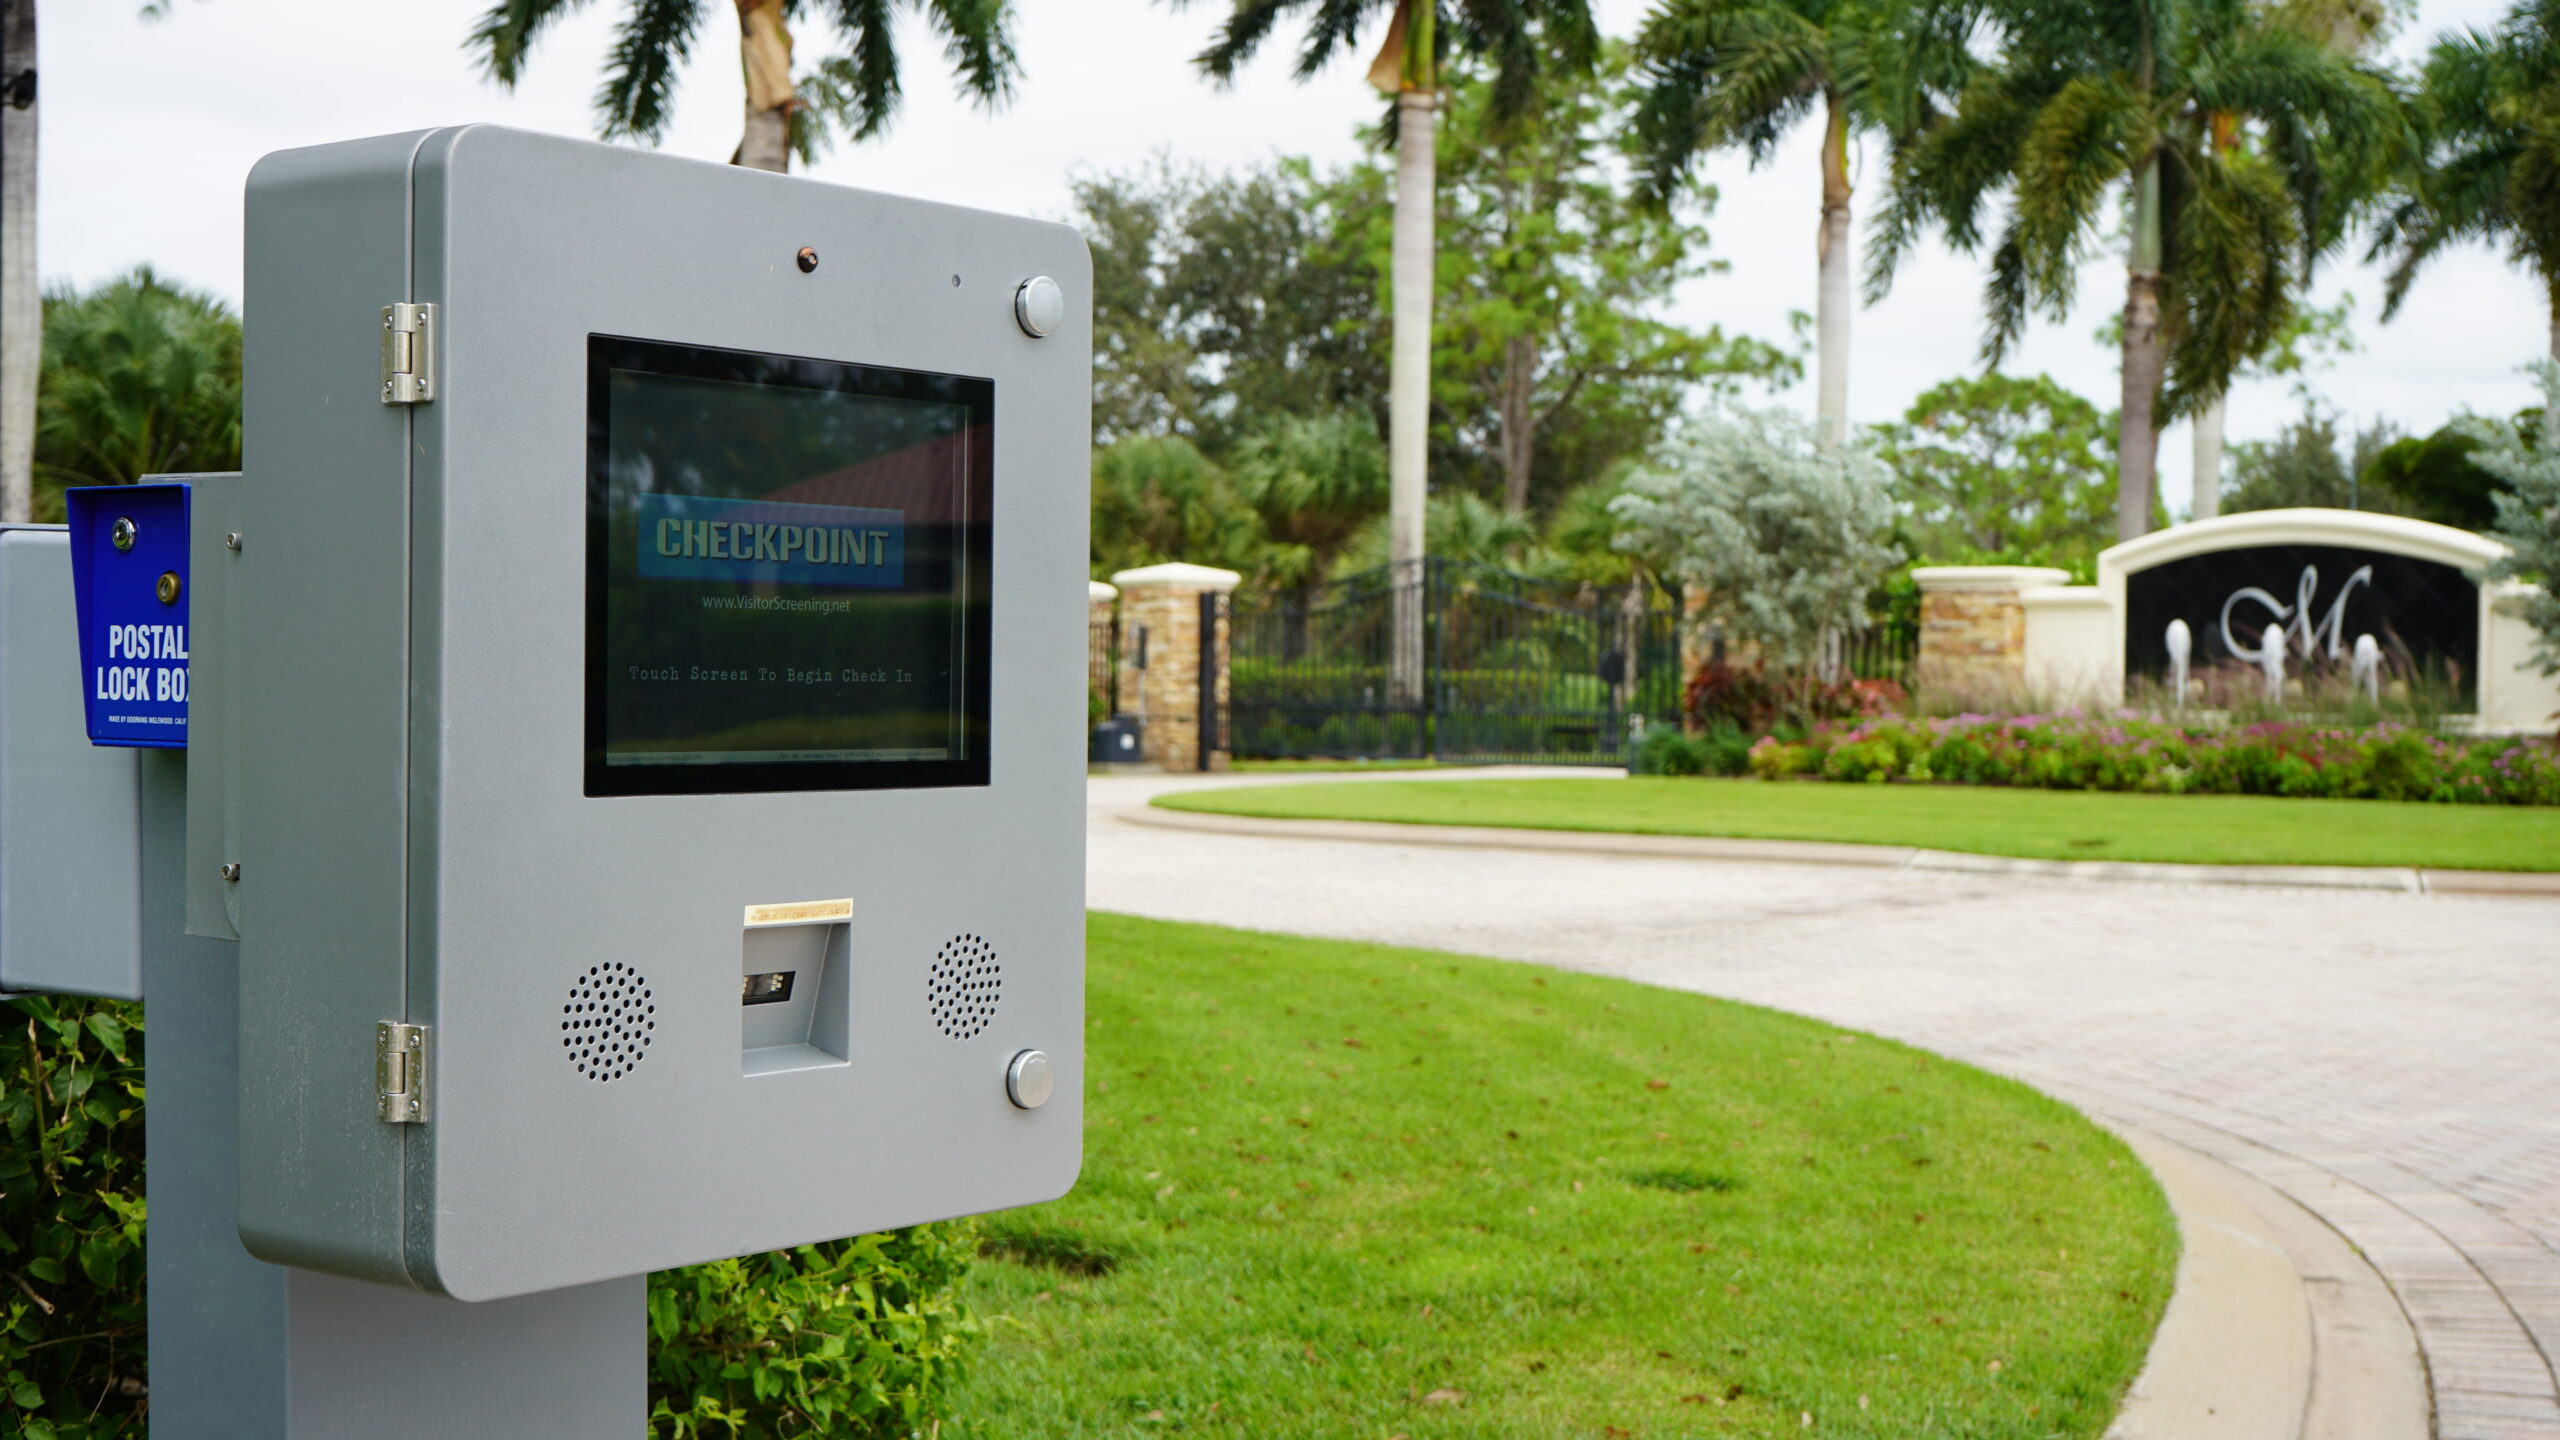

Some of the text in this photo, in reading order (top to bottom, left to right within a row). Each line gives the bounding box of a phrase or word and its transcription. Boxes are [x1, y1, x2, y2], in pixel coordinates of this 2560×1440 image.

[656, 518, 890, 567] CHECKPOINT
[702, 594, 851, 616] www.VisitorScreening.net
[109, 624, 188, 659] POSTAL
[97, 666, 189, 703] LOCK BO
[629, 665, 912, 685] Touch Screen To Begin Check In
